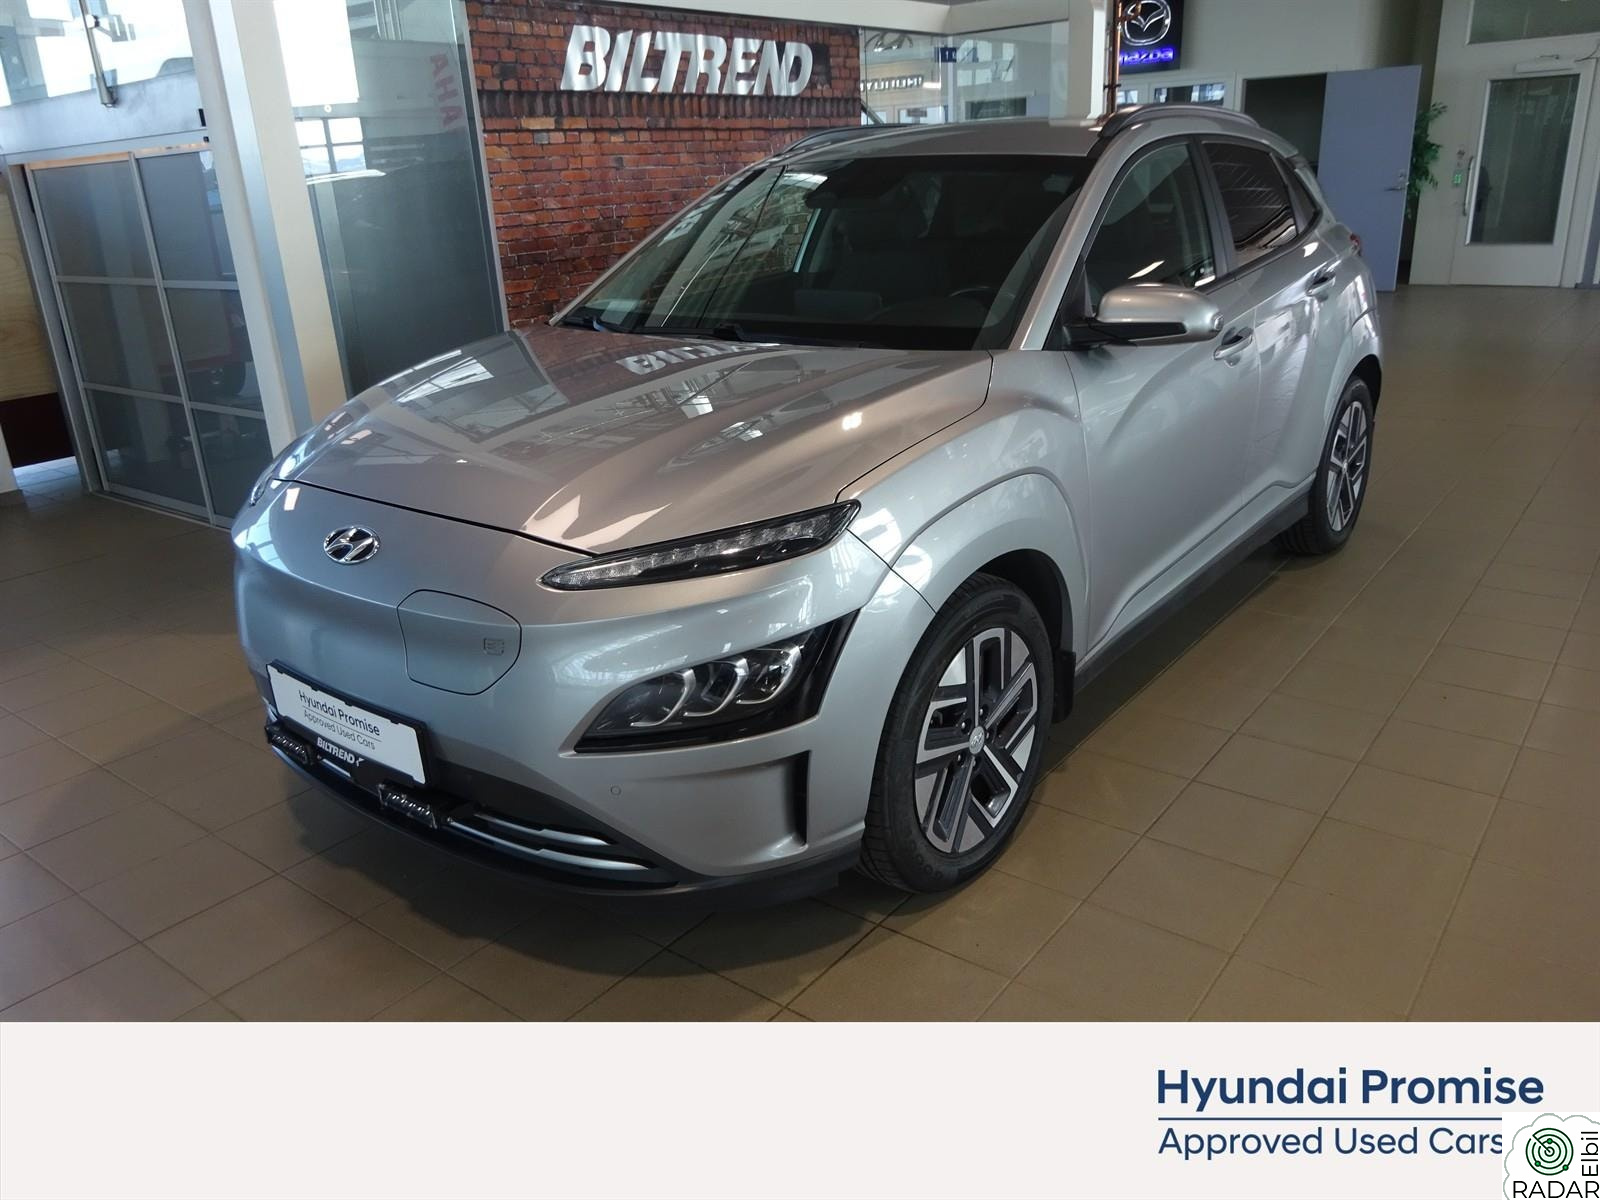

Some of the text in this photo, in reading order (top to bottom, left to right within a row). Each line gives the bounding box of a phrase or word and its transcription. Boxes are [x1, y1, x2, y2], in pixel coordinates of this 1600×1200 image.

[560, 25, 813, 97] BILTREND
[298, 689, 380, 736] Hyundai Promise
[303, 709, 376, 750] Approved Used Cars
[316, 736, 356, 764] BILTREND
